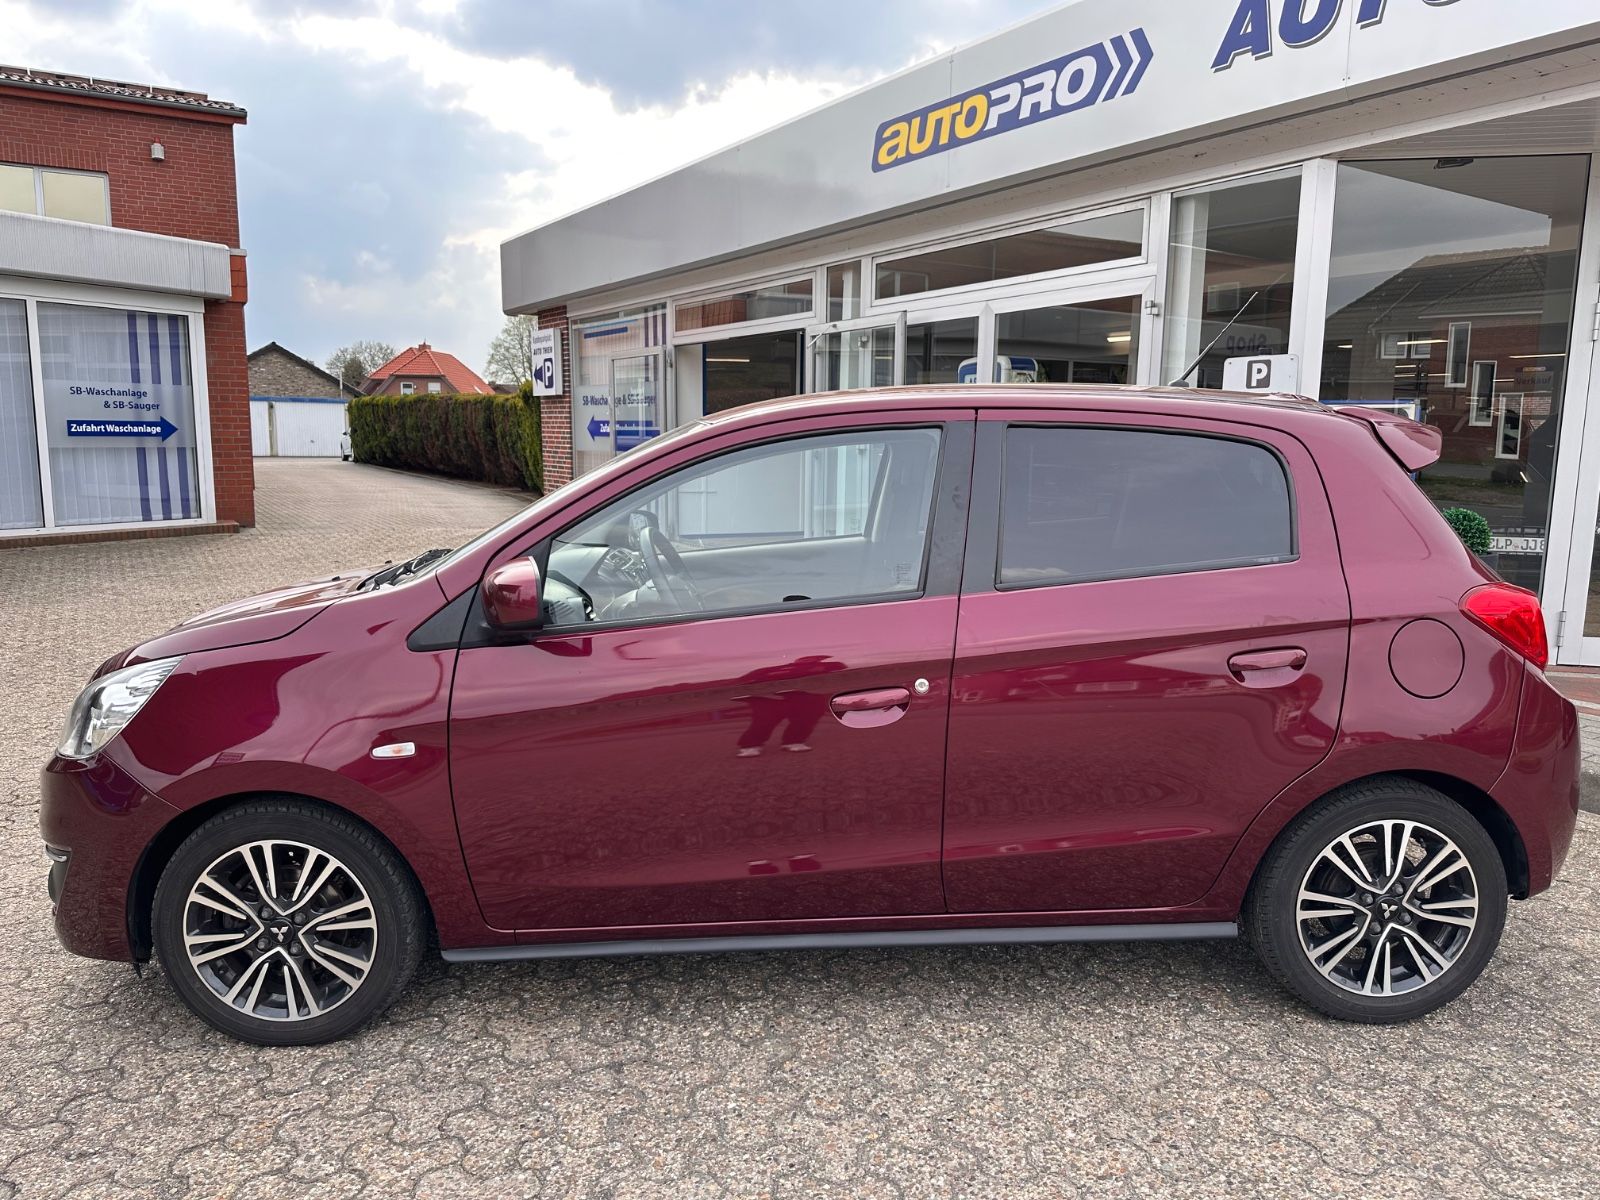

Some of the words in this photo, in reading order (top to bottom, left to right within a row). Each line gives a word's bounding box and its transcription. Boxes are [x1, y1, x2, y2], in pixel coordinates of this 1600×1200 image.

[545, 361, 552, 386] P
[1251, 362, 1268, 386] P
[69, 386, 148, 398] SB-Waschanlage
[103, 401, 111, 409] &
[112, 401, 160, 411] SB-Sauger
[70, 423, 105, 432] Zufahrt
[105, 424, 162, 434] Waschanlage
